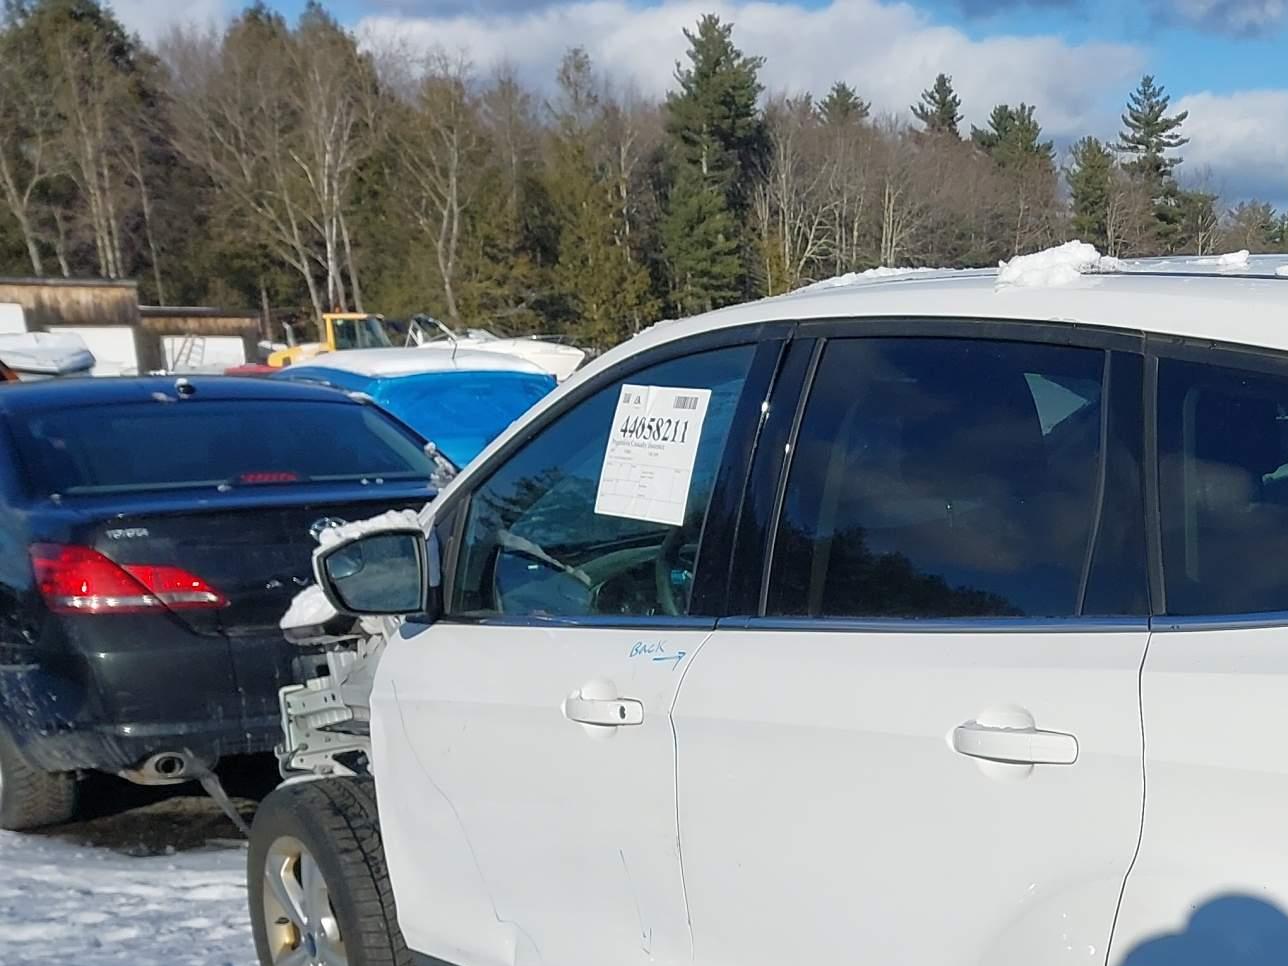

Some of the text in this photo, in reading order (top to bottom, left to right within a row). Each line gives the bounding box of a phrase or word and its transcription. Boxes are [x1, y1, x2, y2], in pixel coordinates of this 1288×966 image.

[619, 415, 690, 443] 44058211
[105, 527, 150, 540] TOYOTA
[629, 640, 667, 658] BACK
